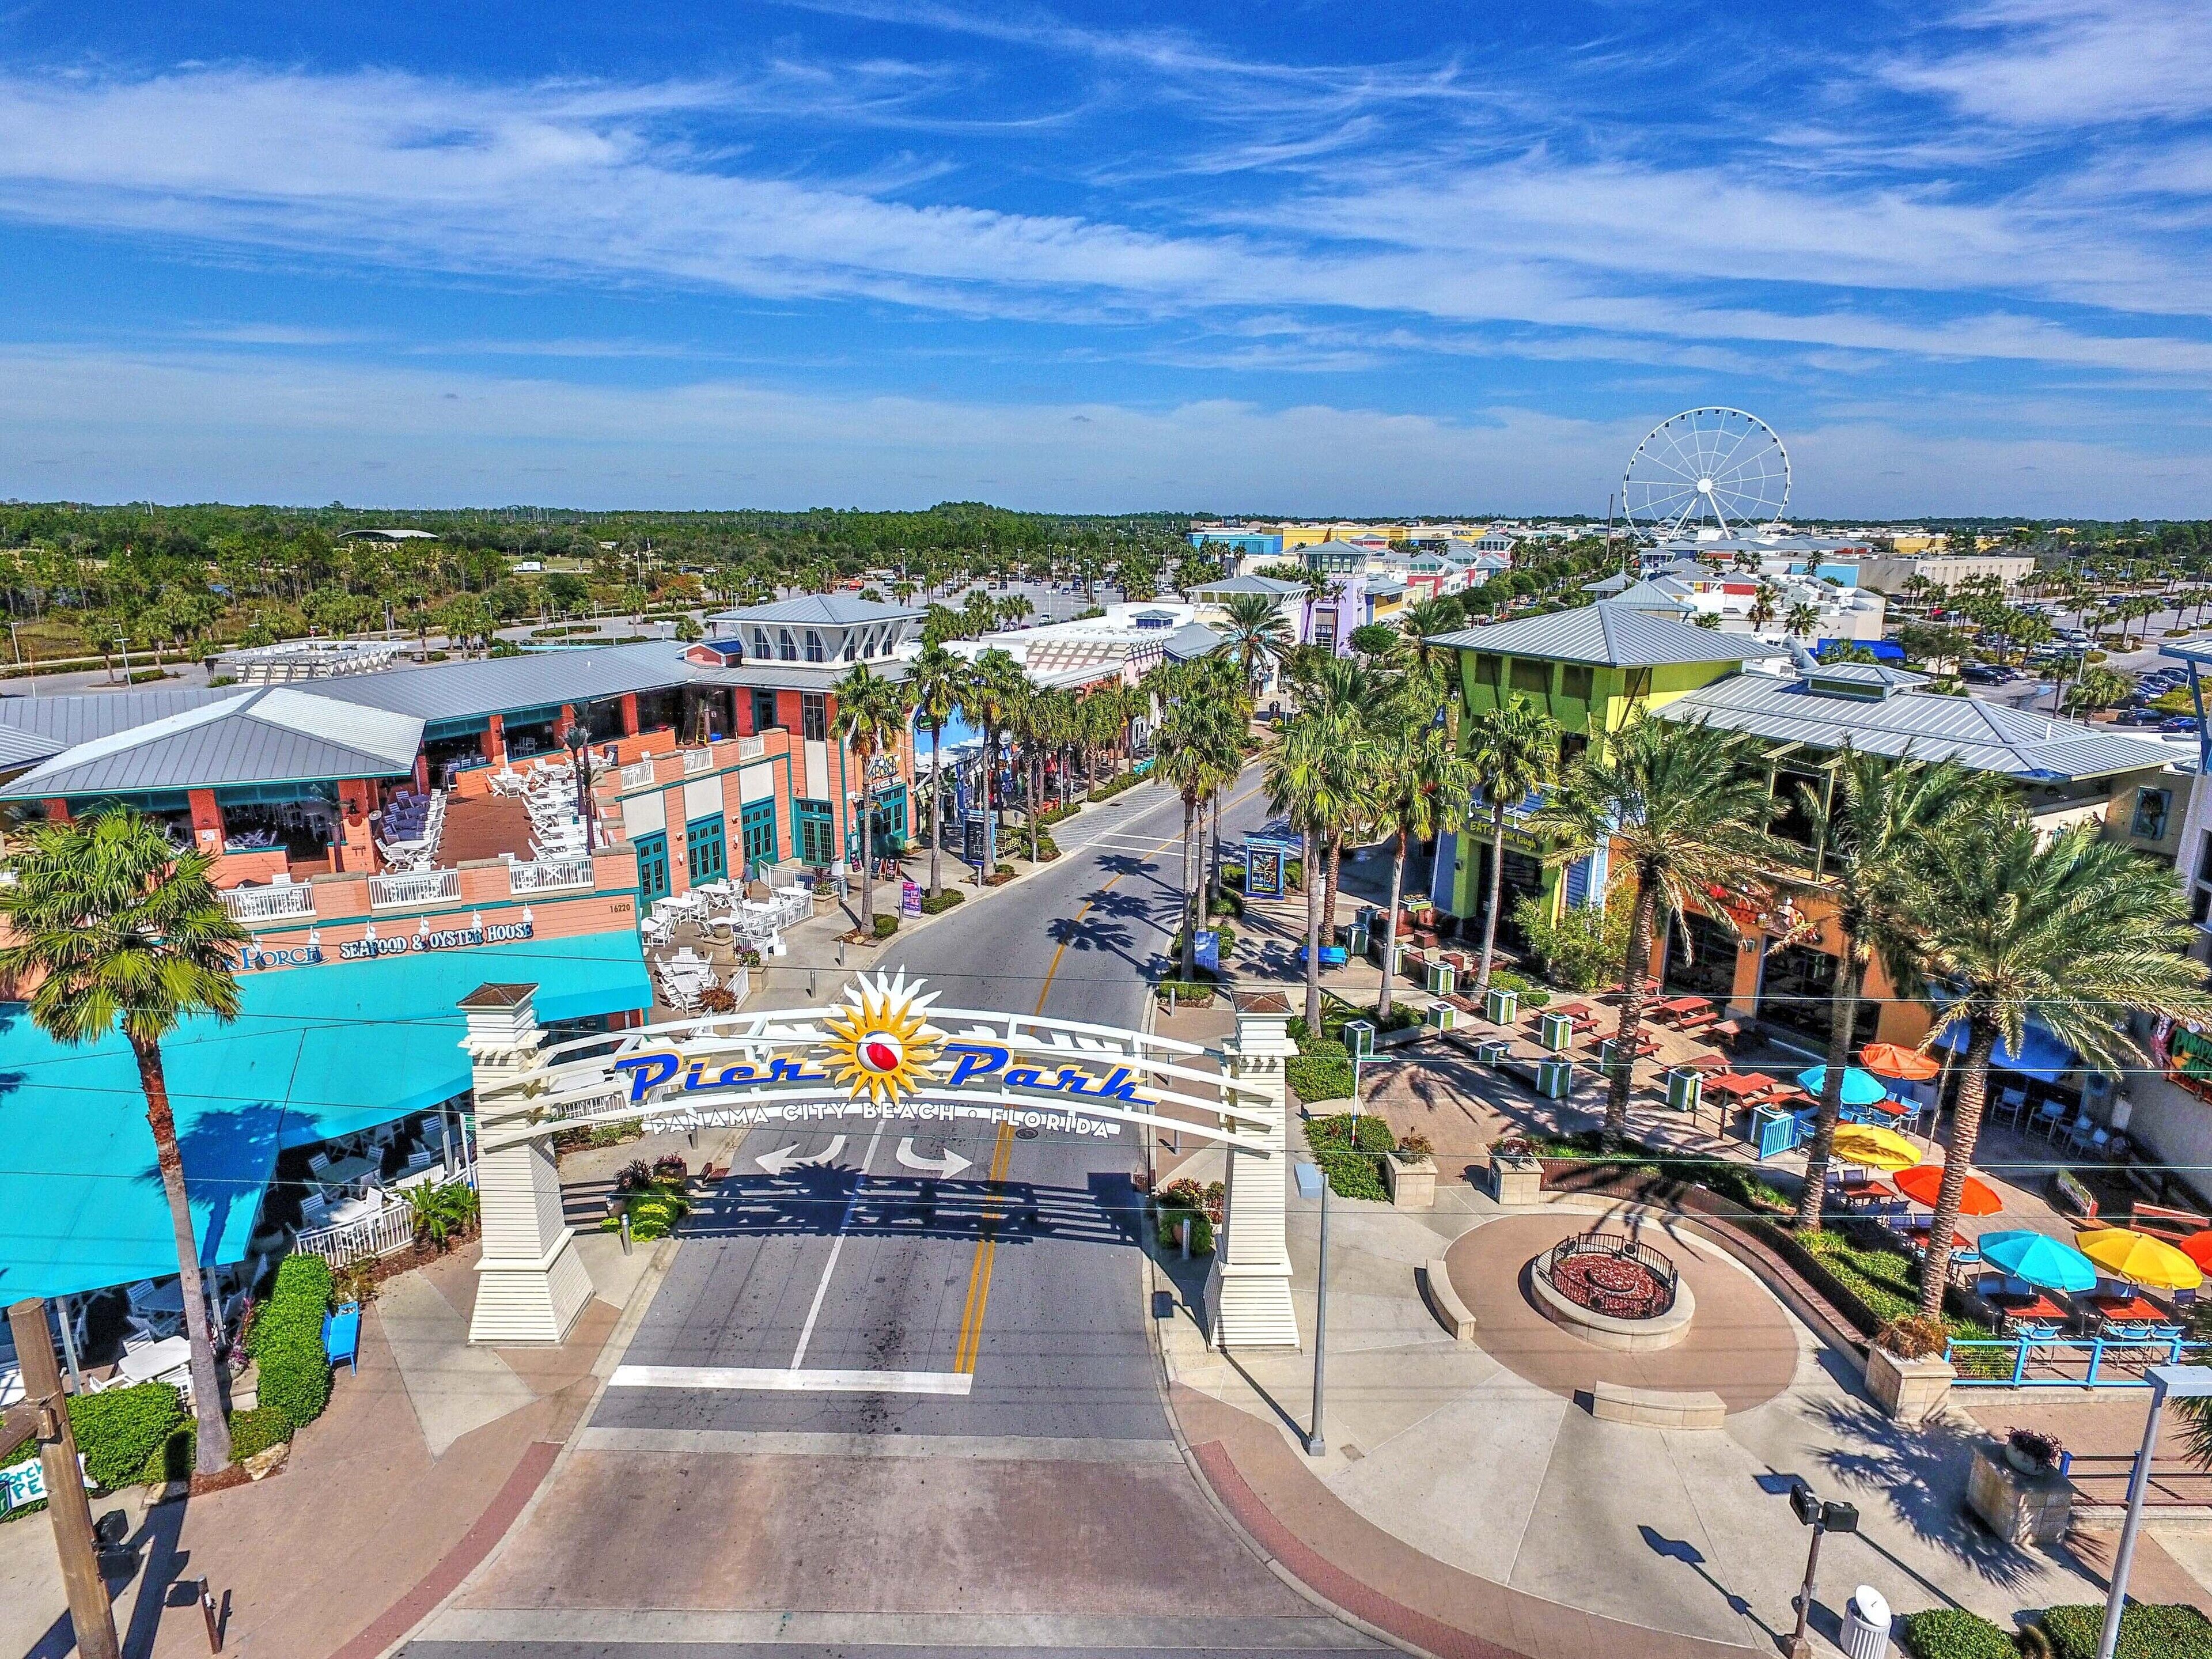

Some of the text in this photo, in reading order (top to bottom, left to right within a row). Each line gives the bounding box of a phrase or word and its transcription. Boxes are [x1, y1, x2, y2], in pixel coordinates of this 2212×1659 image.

[1517, 832, 1537, 851] laugh
[610, 904, 630, 912] 16220
[239, 946, 327, 971] PORCH
[340, 935, 408, 959] SEAFOOD
[411, 934, 425, 951] &
[429, 927, 484, 949] OYSTER
[486, 922, 533, 942] HOUSE
[612, 1037, 1162, 1105] Pier Park
[651, 1101, 1110, 1139] PANAMA CITY BEACH FLORIDA
